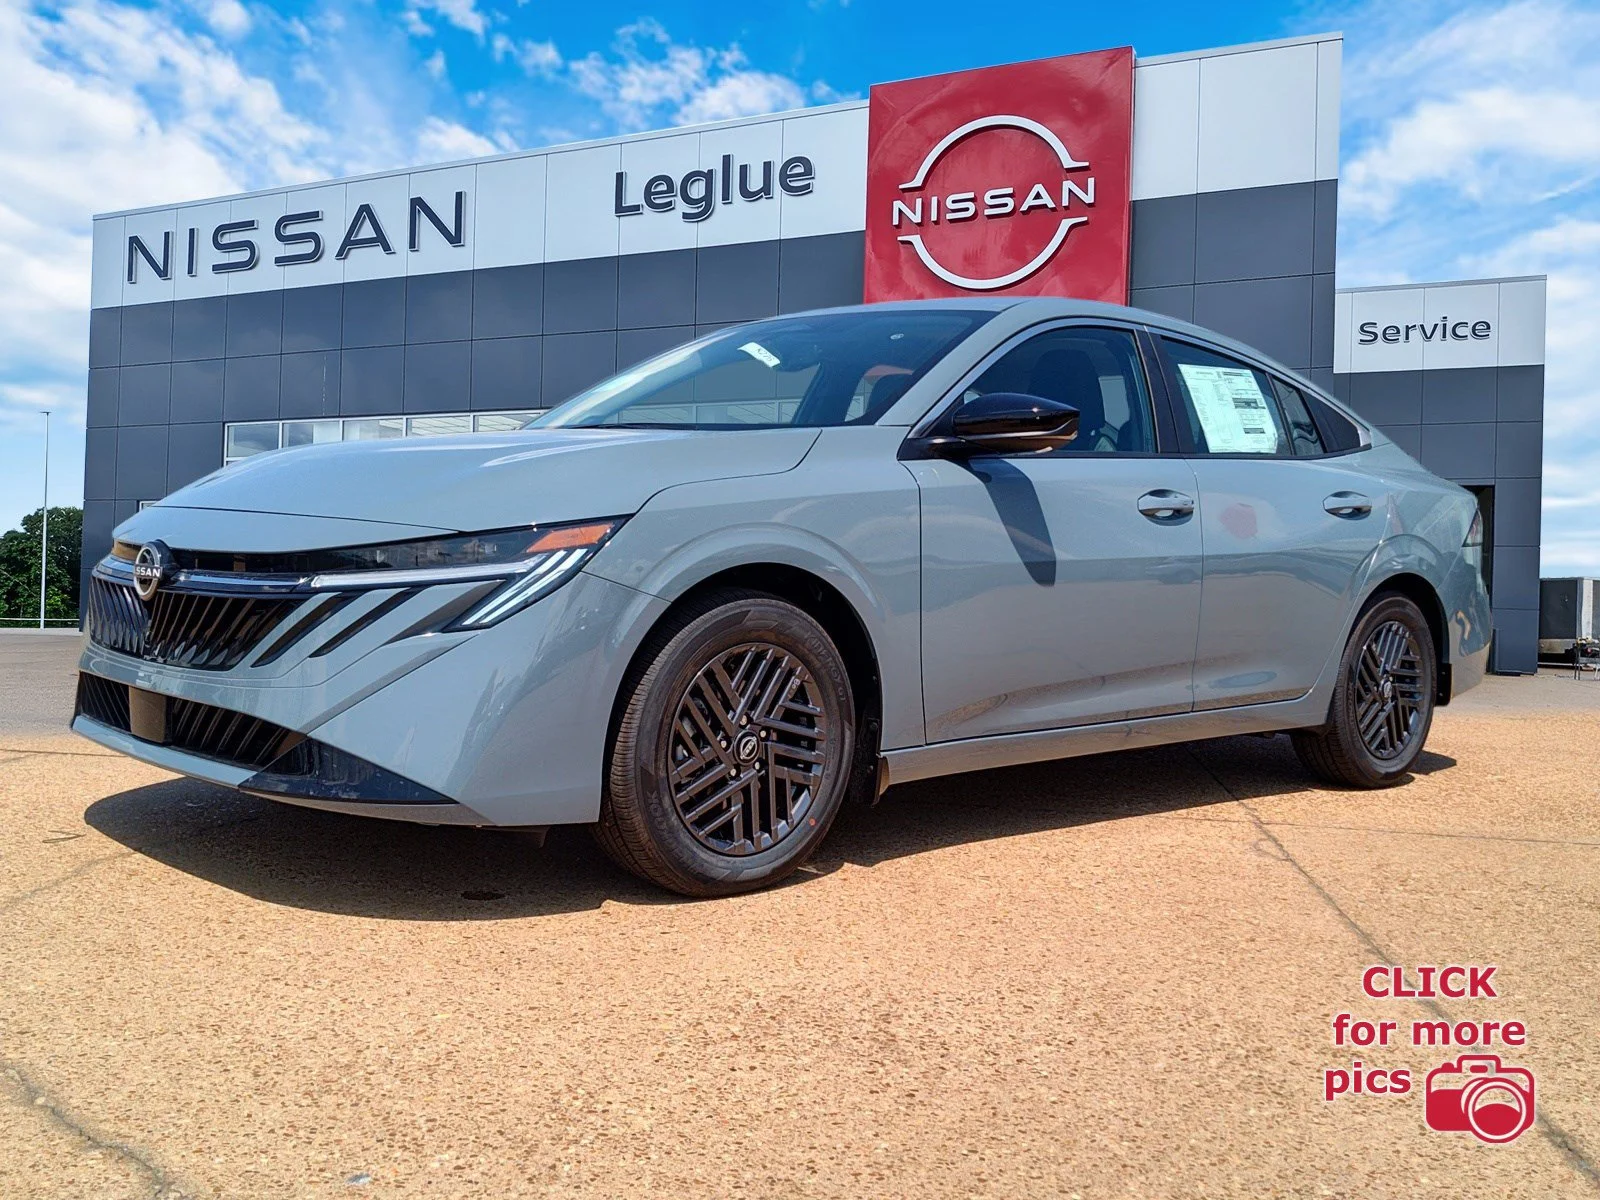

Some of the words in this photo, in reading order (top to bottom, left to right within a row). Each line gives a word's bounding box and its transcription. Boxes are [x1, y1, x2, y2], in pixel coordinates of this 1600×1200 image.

[614, 153, 815, 222] Leglue
[892, 177, 1095, 227] NISSAN
[127, 190, 466, 284] NISSAN
[1358, 316, 1491, 345] Service
[135, 566, 161, 577] SSAN
